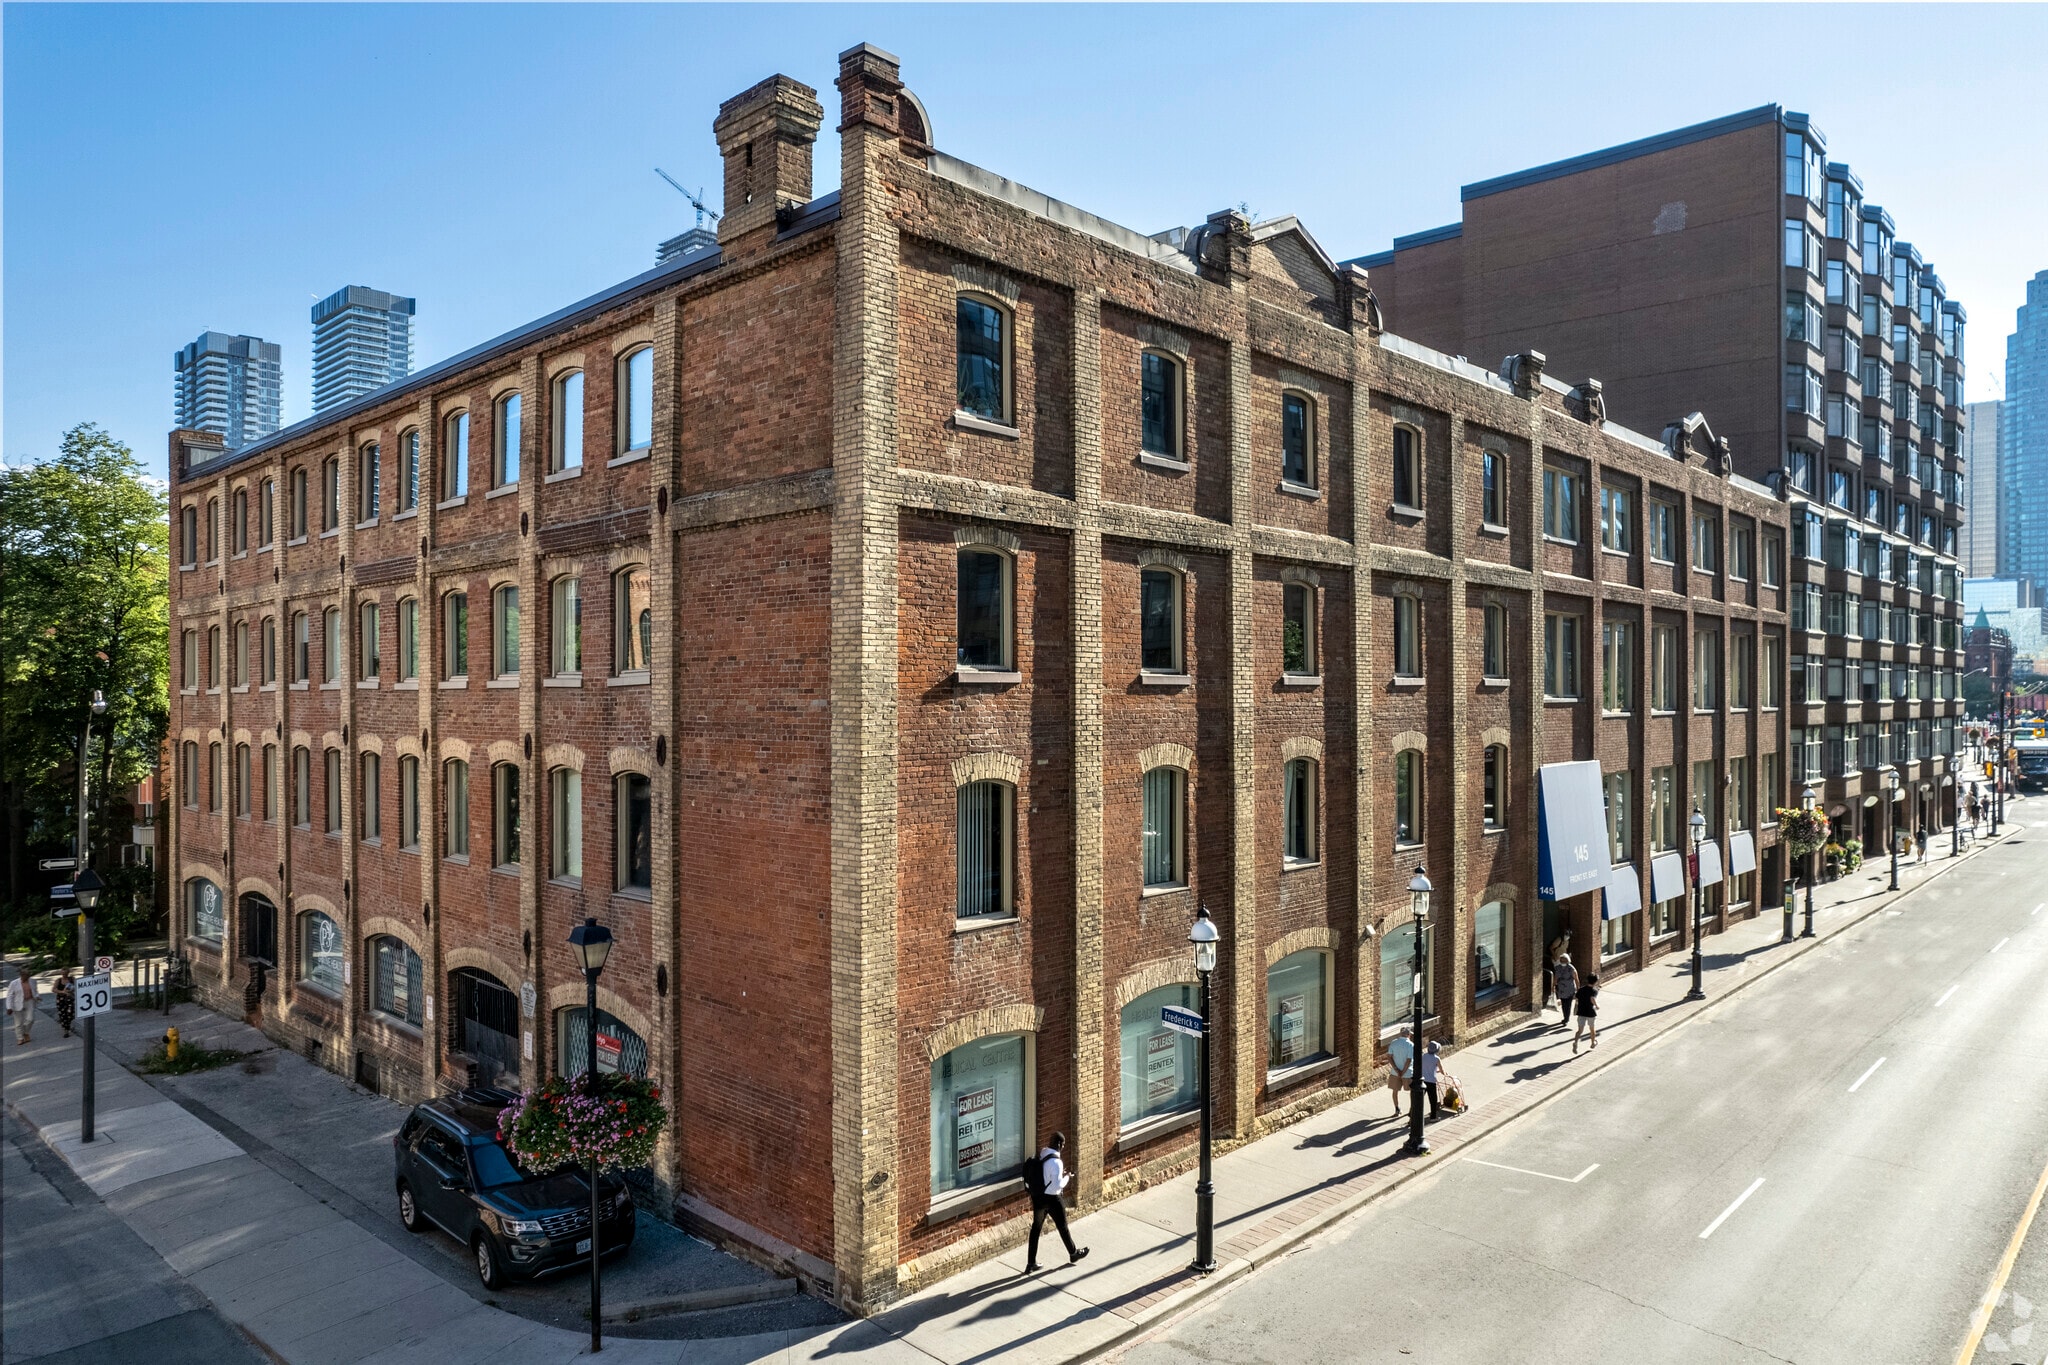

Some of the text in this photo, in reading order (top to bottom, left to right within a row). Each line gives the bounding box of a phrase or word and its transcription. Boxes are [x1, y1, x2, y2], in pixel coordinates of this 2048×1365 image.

[1573, 844, 1589, 863] 145
[1540, 886, 1554, 895] 145
[78, 977, 109, 989] MAXIMUM
[80, 990, 108, 1011] 30
[1164, 1011, 1193, 1028] Frederick
[1149, 1034, 1174, 1050] FOR LEASE
[1149, 1057, 1174, 1072] RENTEX
[960, 1092, 993, 1113] FOR LEASE
[959, 1118, 993, 1137] RENTEX
